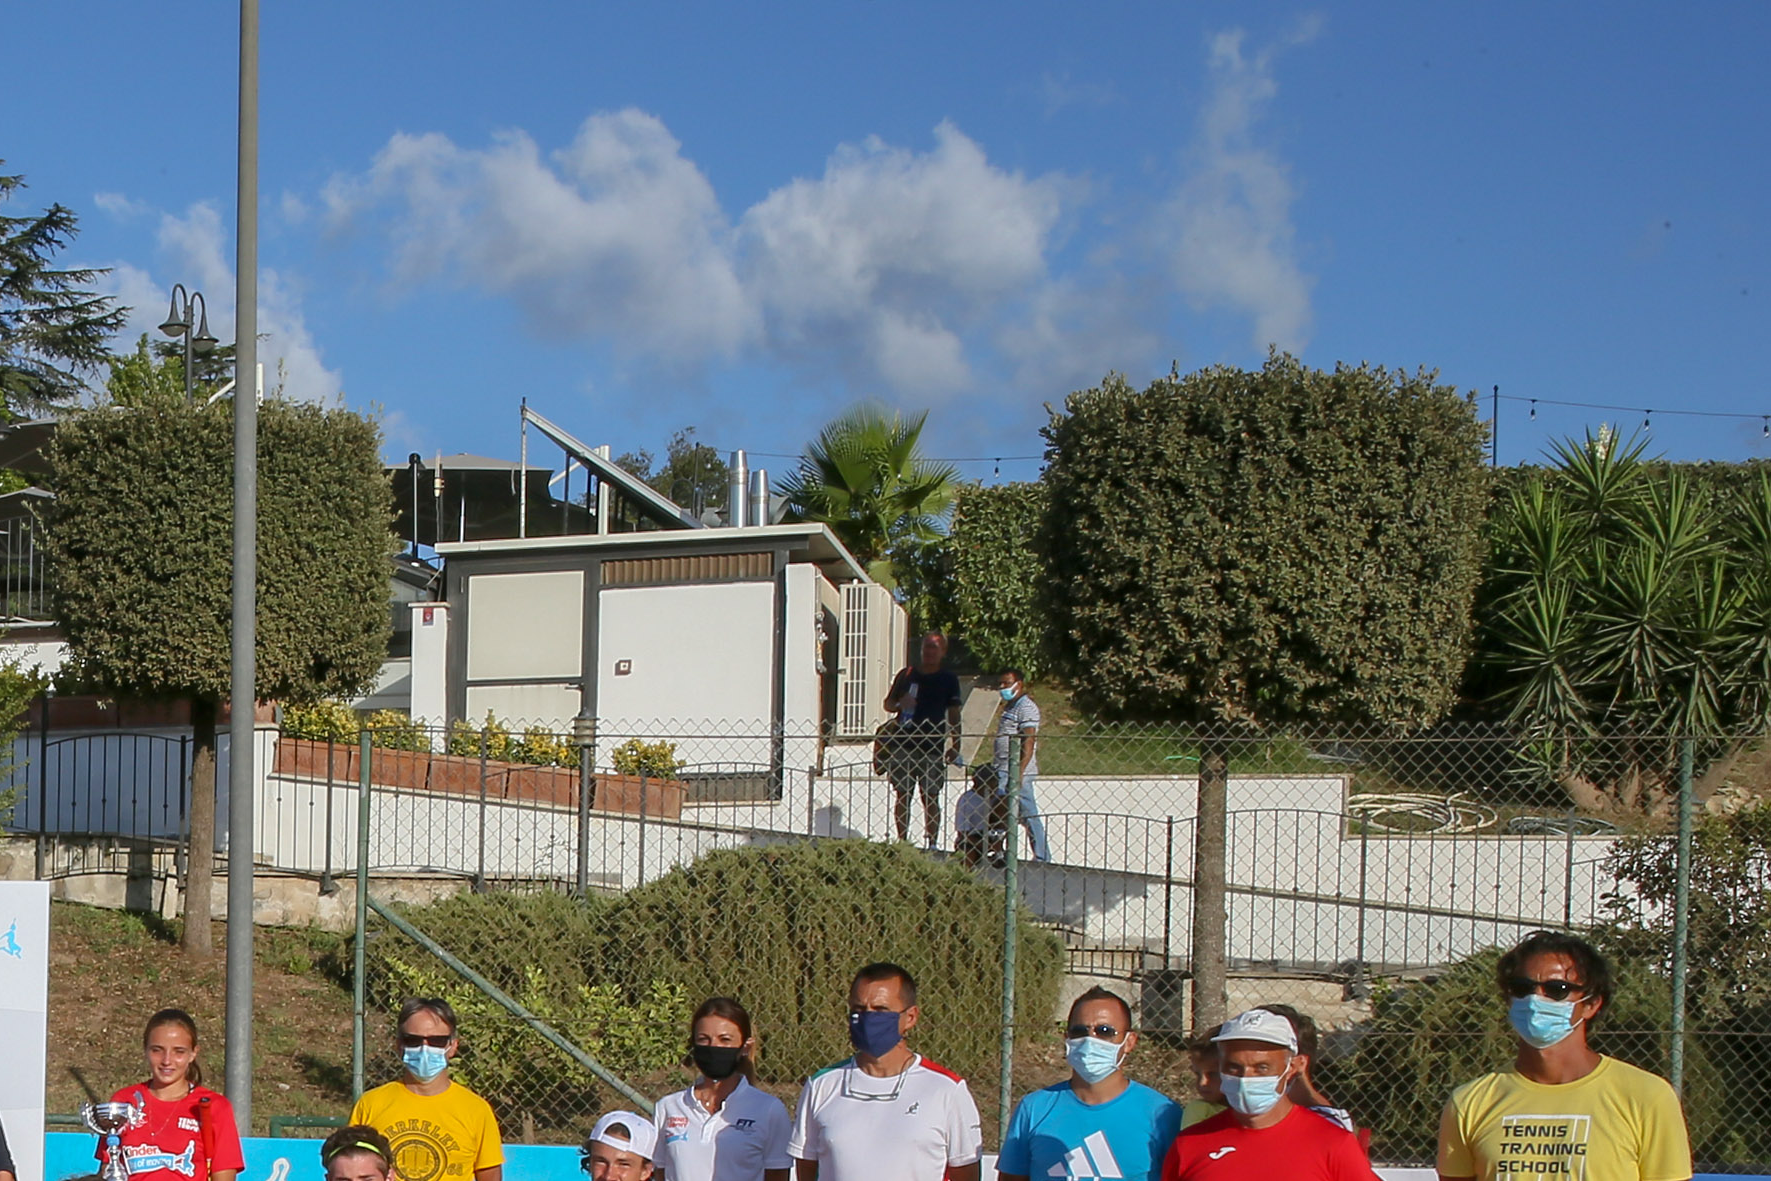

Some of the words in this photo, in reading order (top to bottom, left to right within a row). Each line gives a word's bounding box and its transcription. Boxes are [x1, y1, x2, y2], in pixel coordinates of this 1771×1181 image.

[736, 1118, 756, 1127] FIT
[384, 1119, 460, 1152] ERKELEY
[1502, 1125, 1568, 1138] TENNIS
[1500, 1142, 1587, 1156] TRAINING
[1498, 1160, 1570, 1174] SCHOOL
